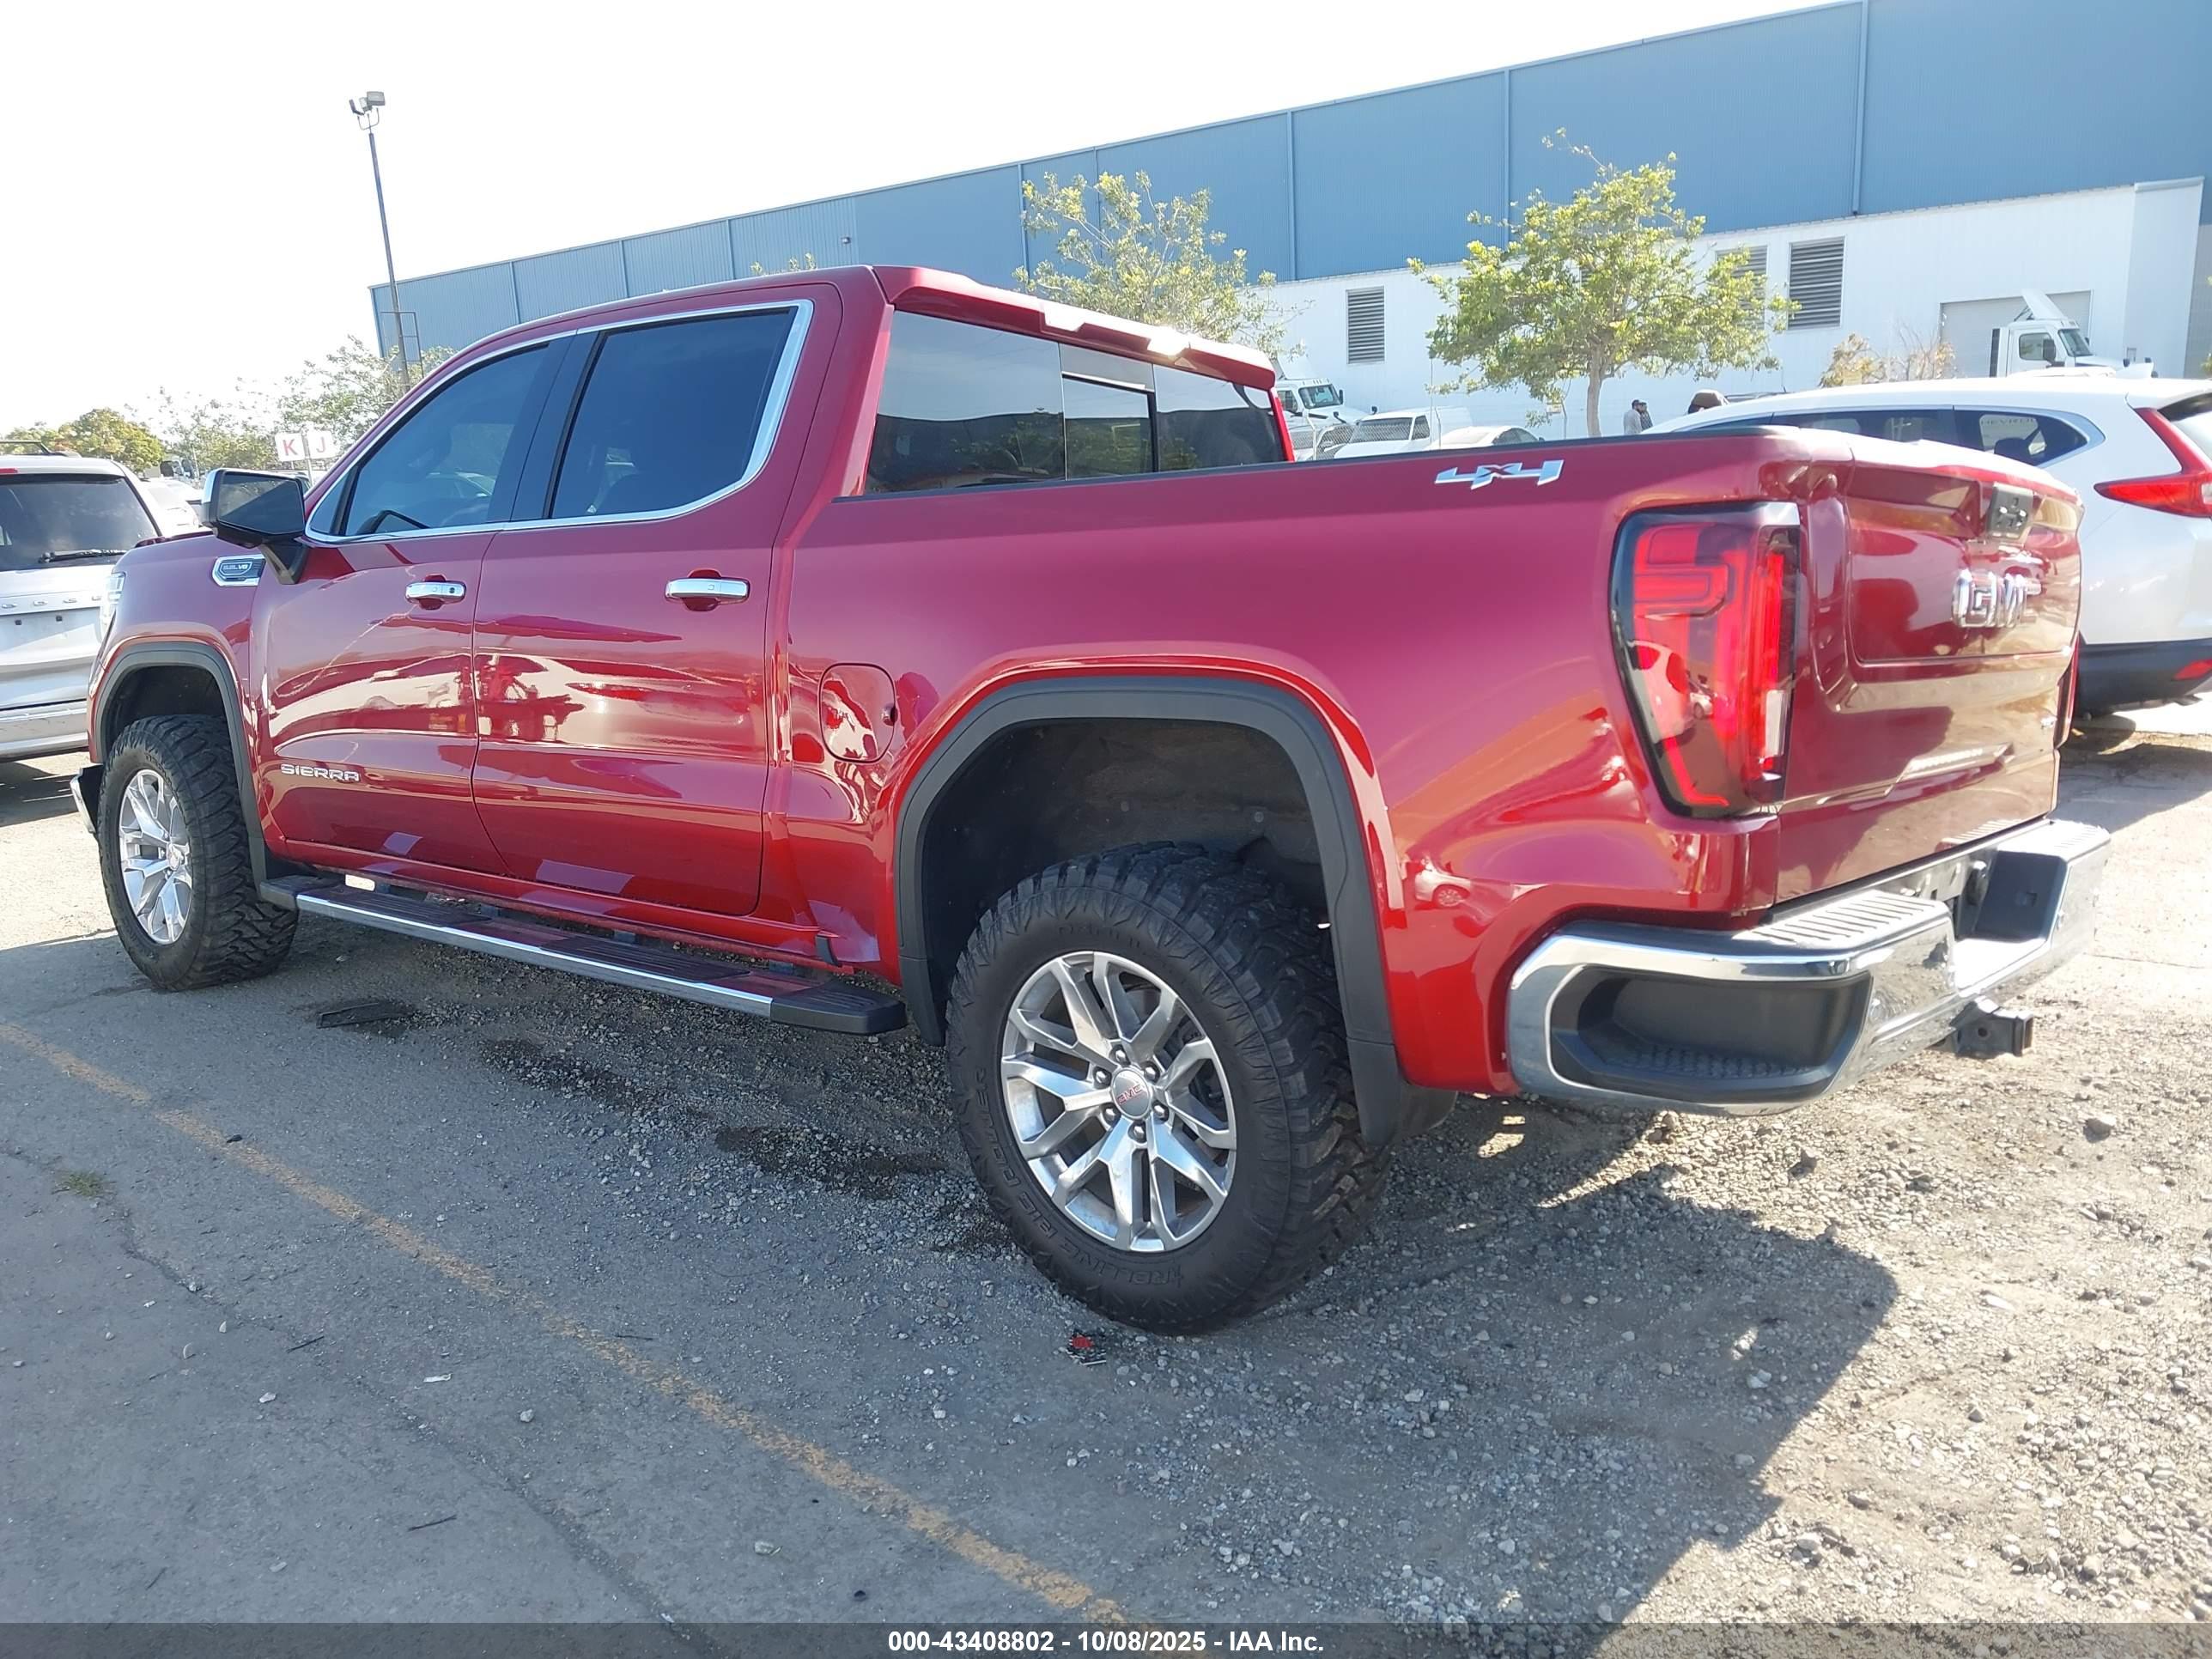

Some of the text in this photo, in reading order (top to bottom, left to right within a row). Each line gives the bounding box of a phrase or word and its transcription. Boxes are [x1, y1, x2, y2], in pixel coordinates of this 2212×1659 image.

[283, 439, 298, 456] K
[316, 436, 325, 453] J
[281, 763, 360, 782] SIERRA
[1117, 1084, 1143, 1104] GMC
